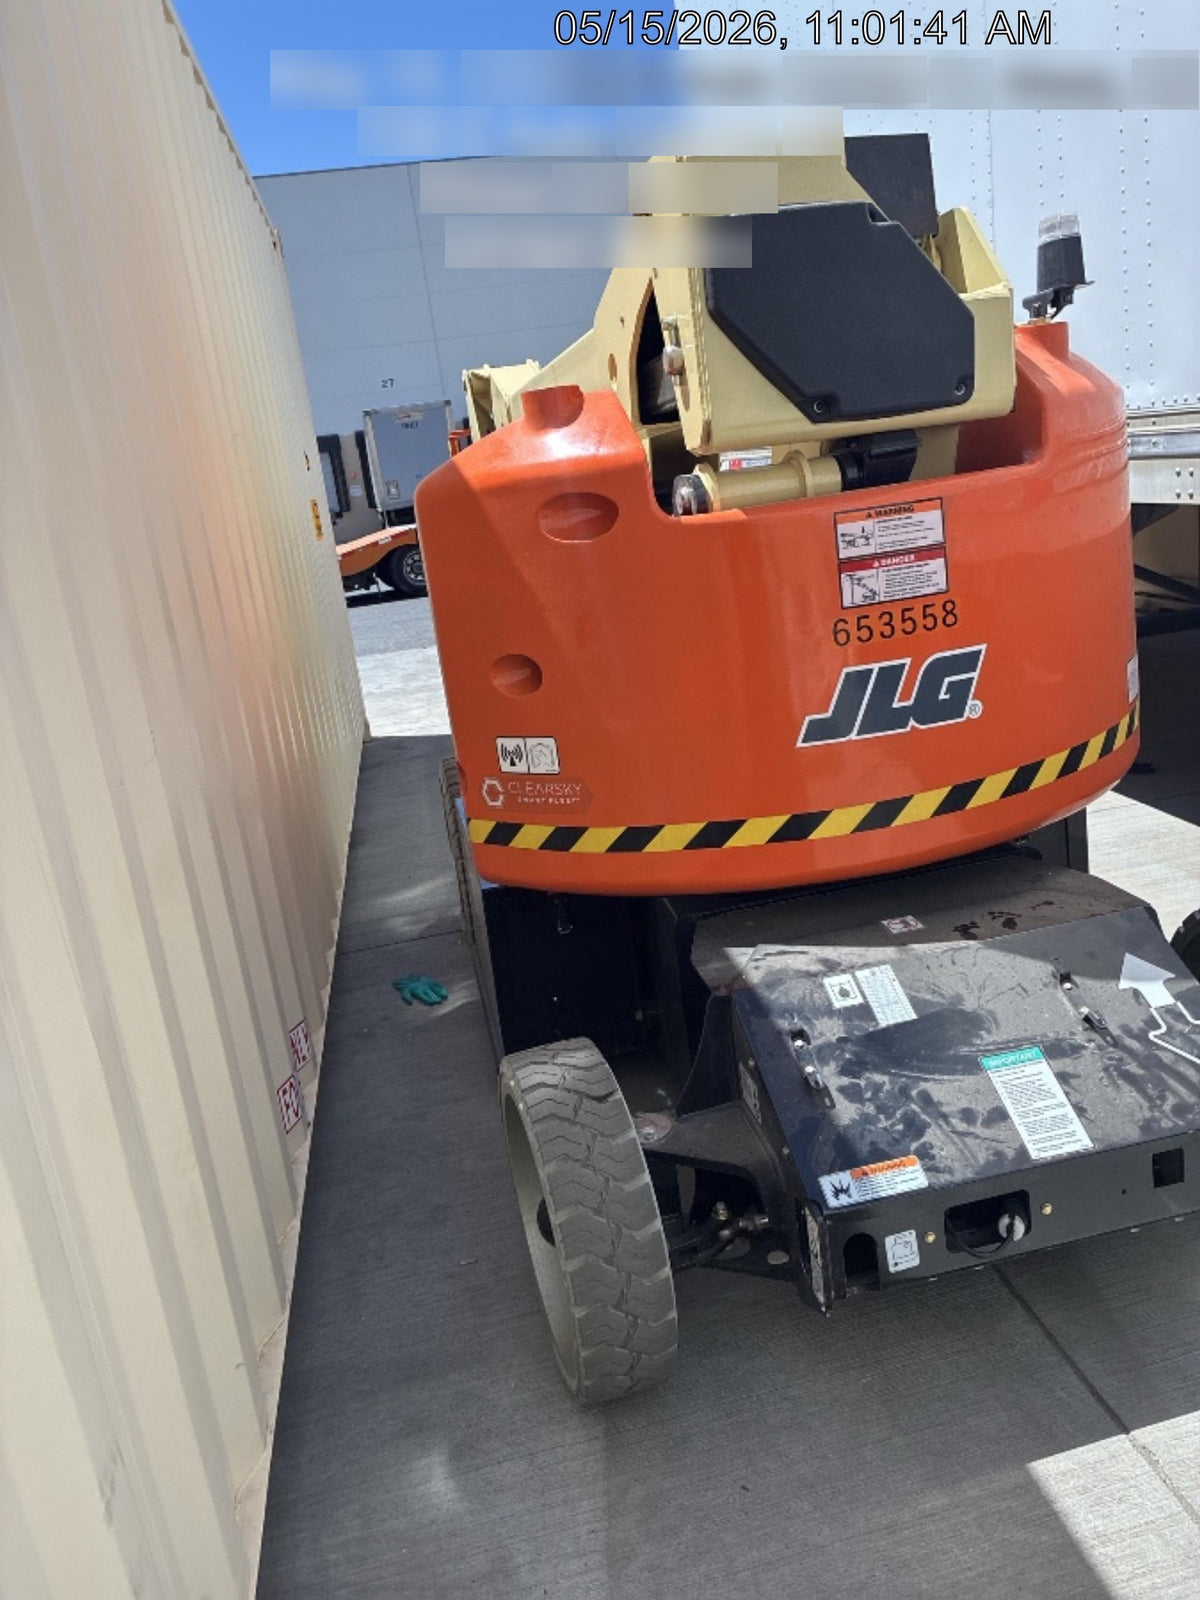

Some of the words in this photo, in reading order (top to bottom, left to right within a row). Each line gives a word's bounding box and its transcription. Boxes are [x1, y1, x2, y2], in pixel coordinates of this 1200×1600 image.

[833, 600, 958, 647] 653558
[796, 643, 988, 748] JLG
[508, 781, 582, 796] CLEARSKY
